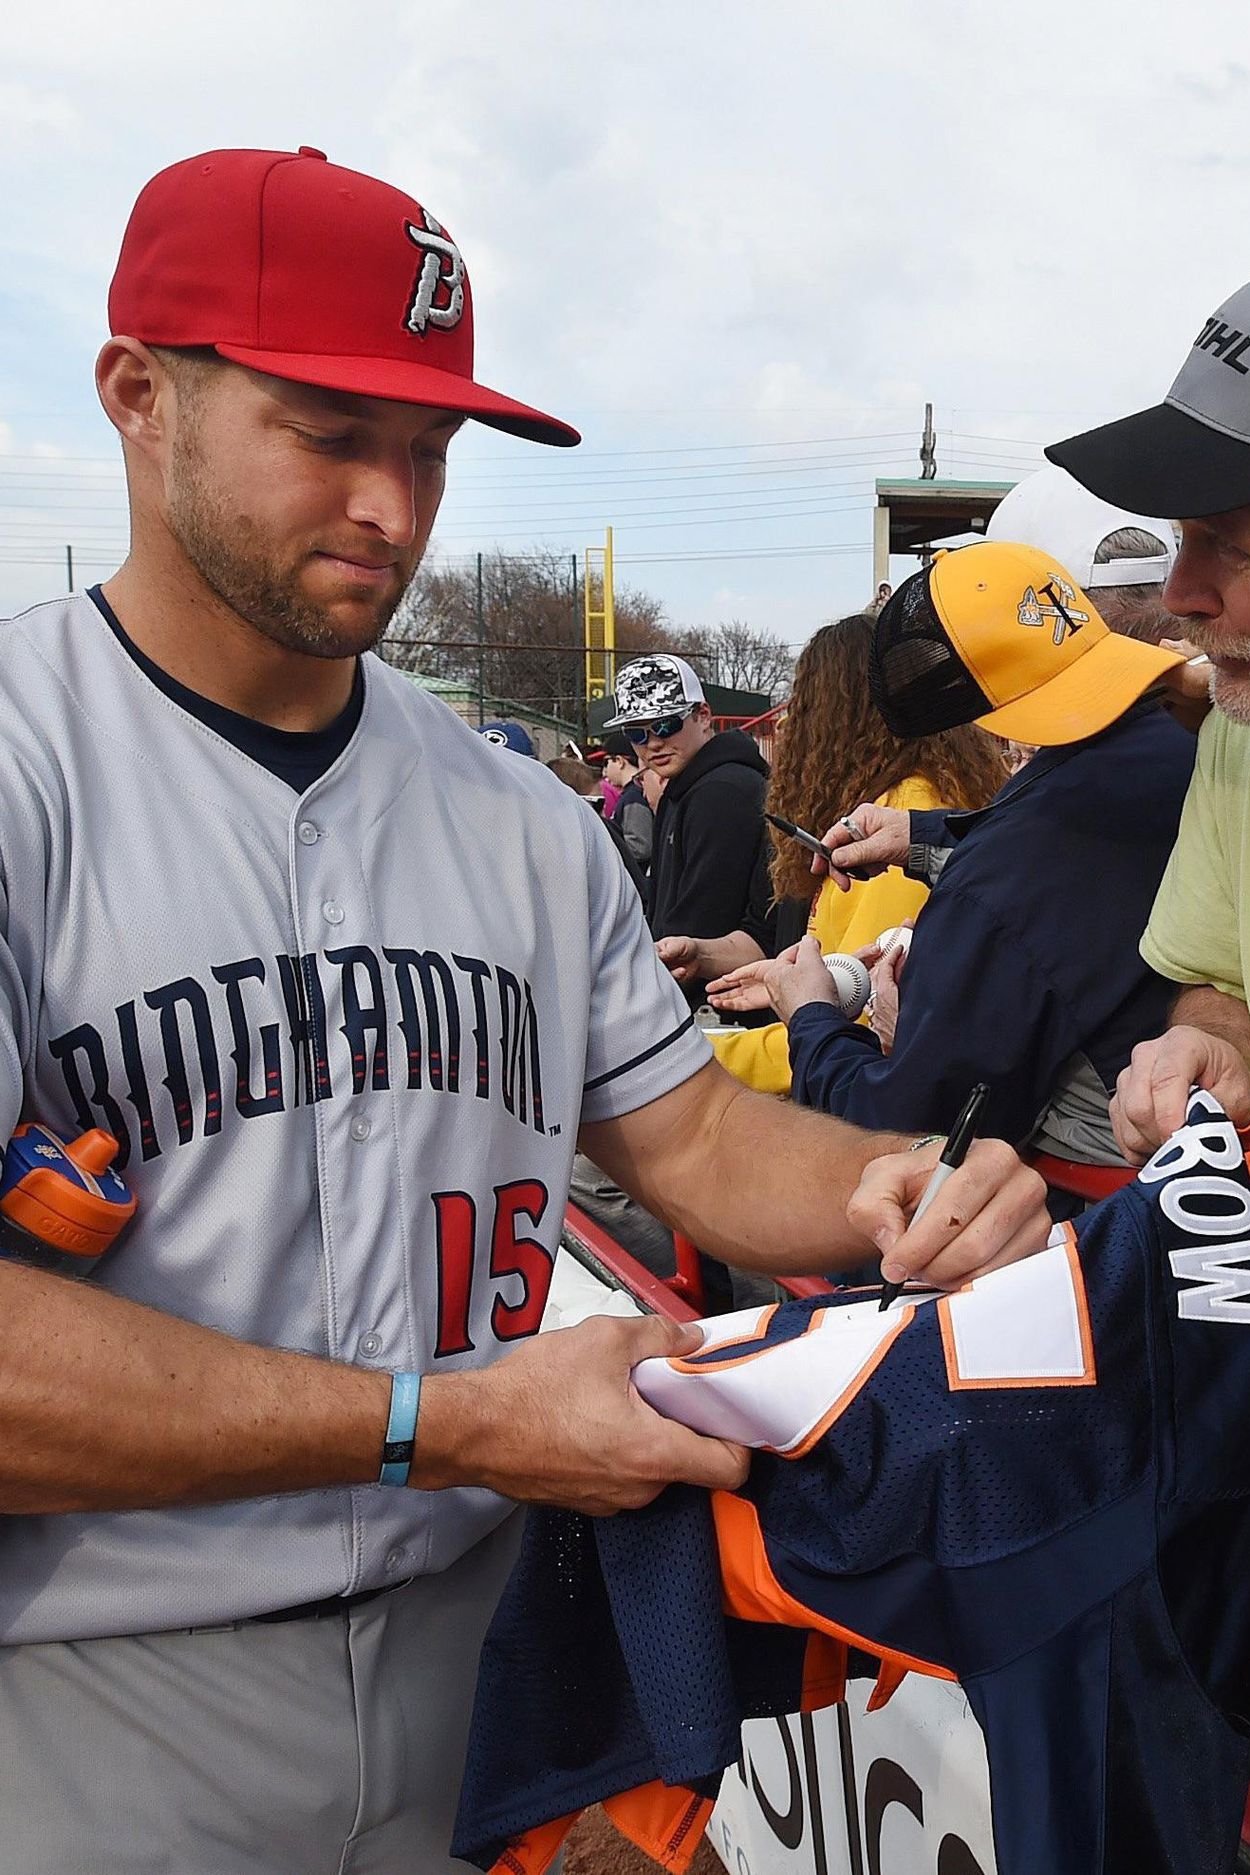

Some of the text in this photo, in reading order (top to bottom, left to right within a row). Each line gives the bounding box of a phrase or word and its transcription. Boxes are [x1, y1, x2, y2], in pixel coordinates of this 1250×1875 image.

[403, 206, 465, 338] B
[48, 945, 546, 1169] BINGHAMTON
[430, 1178, 554, 1360] 15
